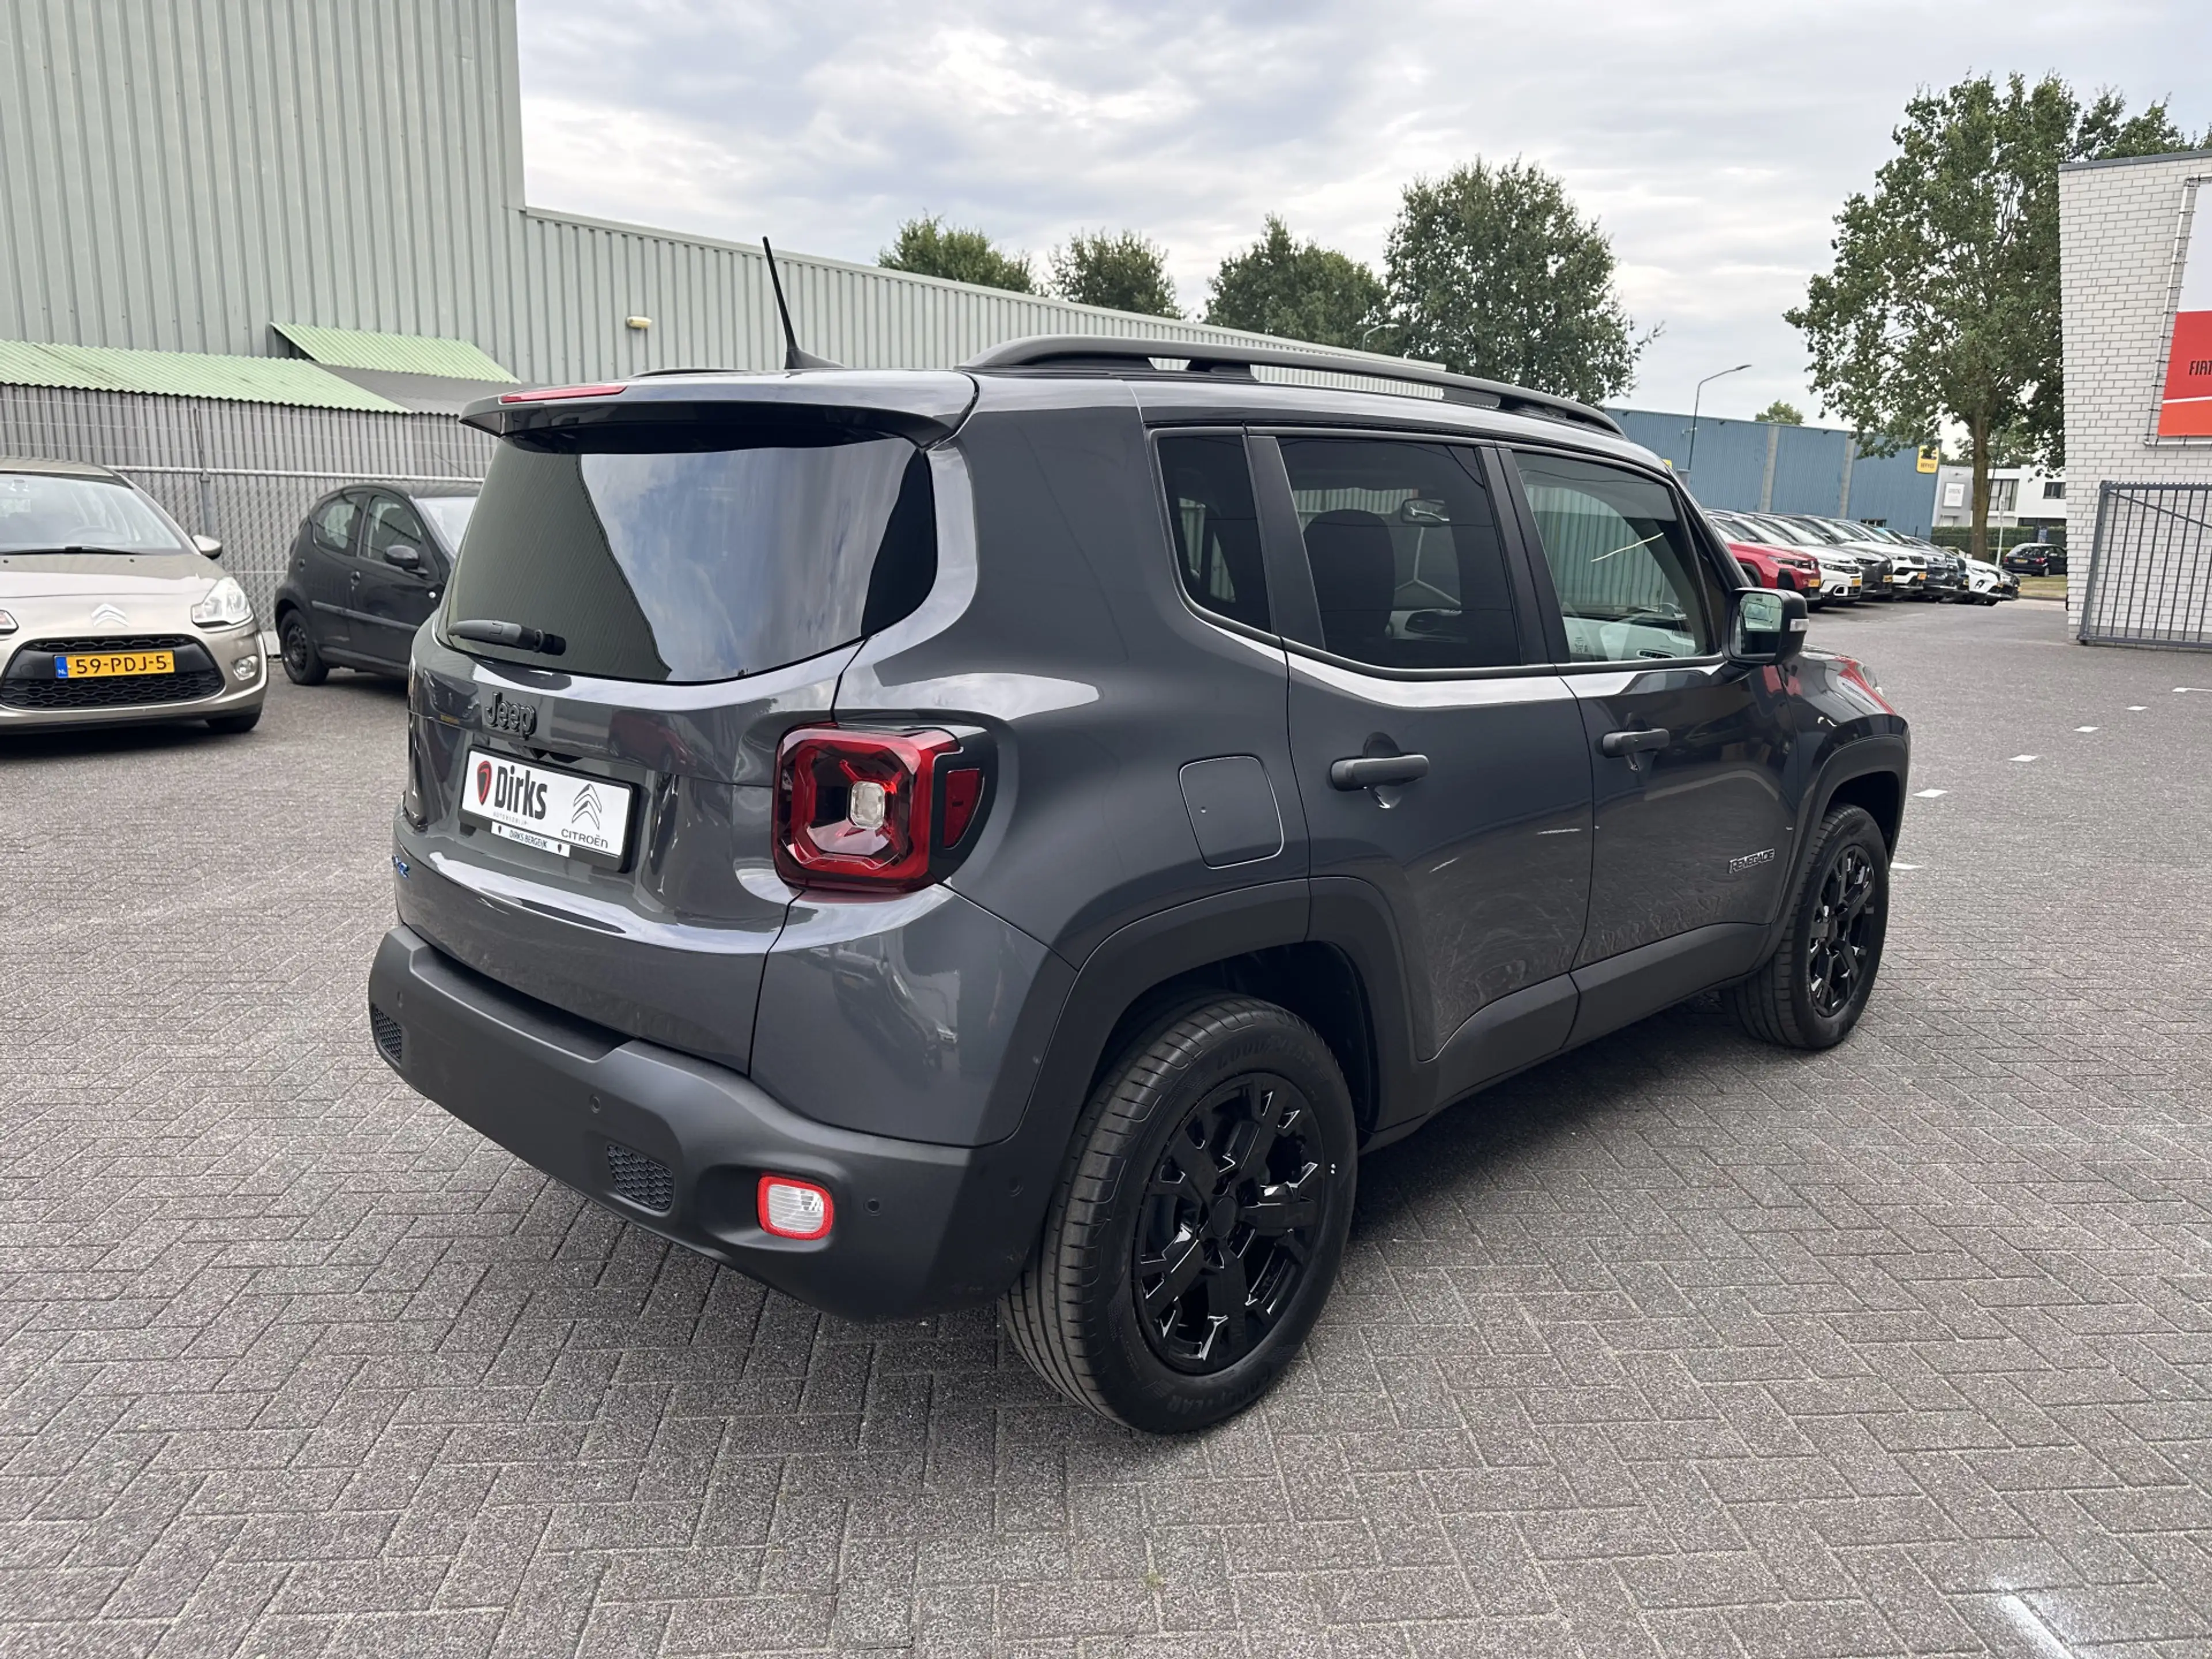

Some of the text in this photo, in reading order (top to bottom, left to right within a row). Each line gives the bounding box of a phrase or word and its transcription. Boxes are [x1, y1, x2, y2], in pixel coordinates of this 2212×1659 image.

[2189, 360, 2212, 376] FIAT
[76, 656, 167, 675] 59-PDJ-5
[484, 691, 537, 741] Jeep
[494, 765, 547, 820] Dirks
[509, 830, 524, 842] DIRKS
[1729, 849, 1775, 874] RENEGADE
